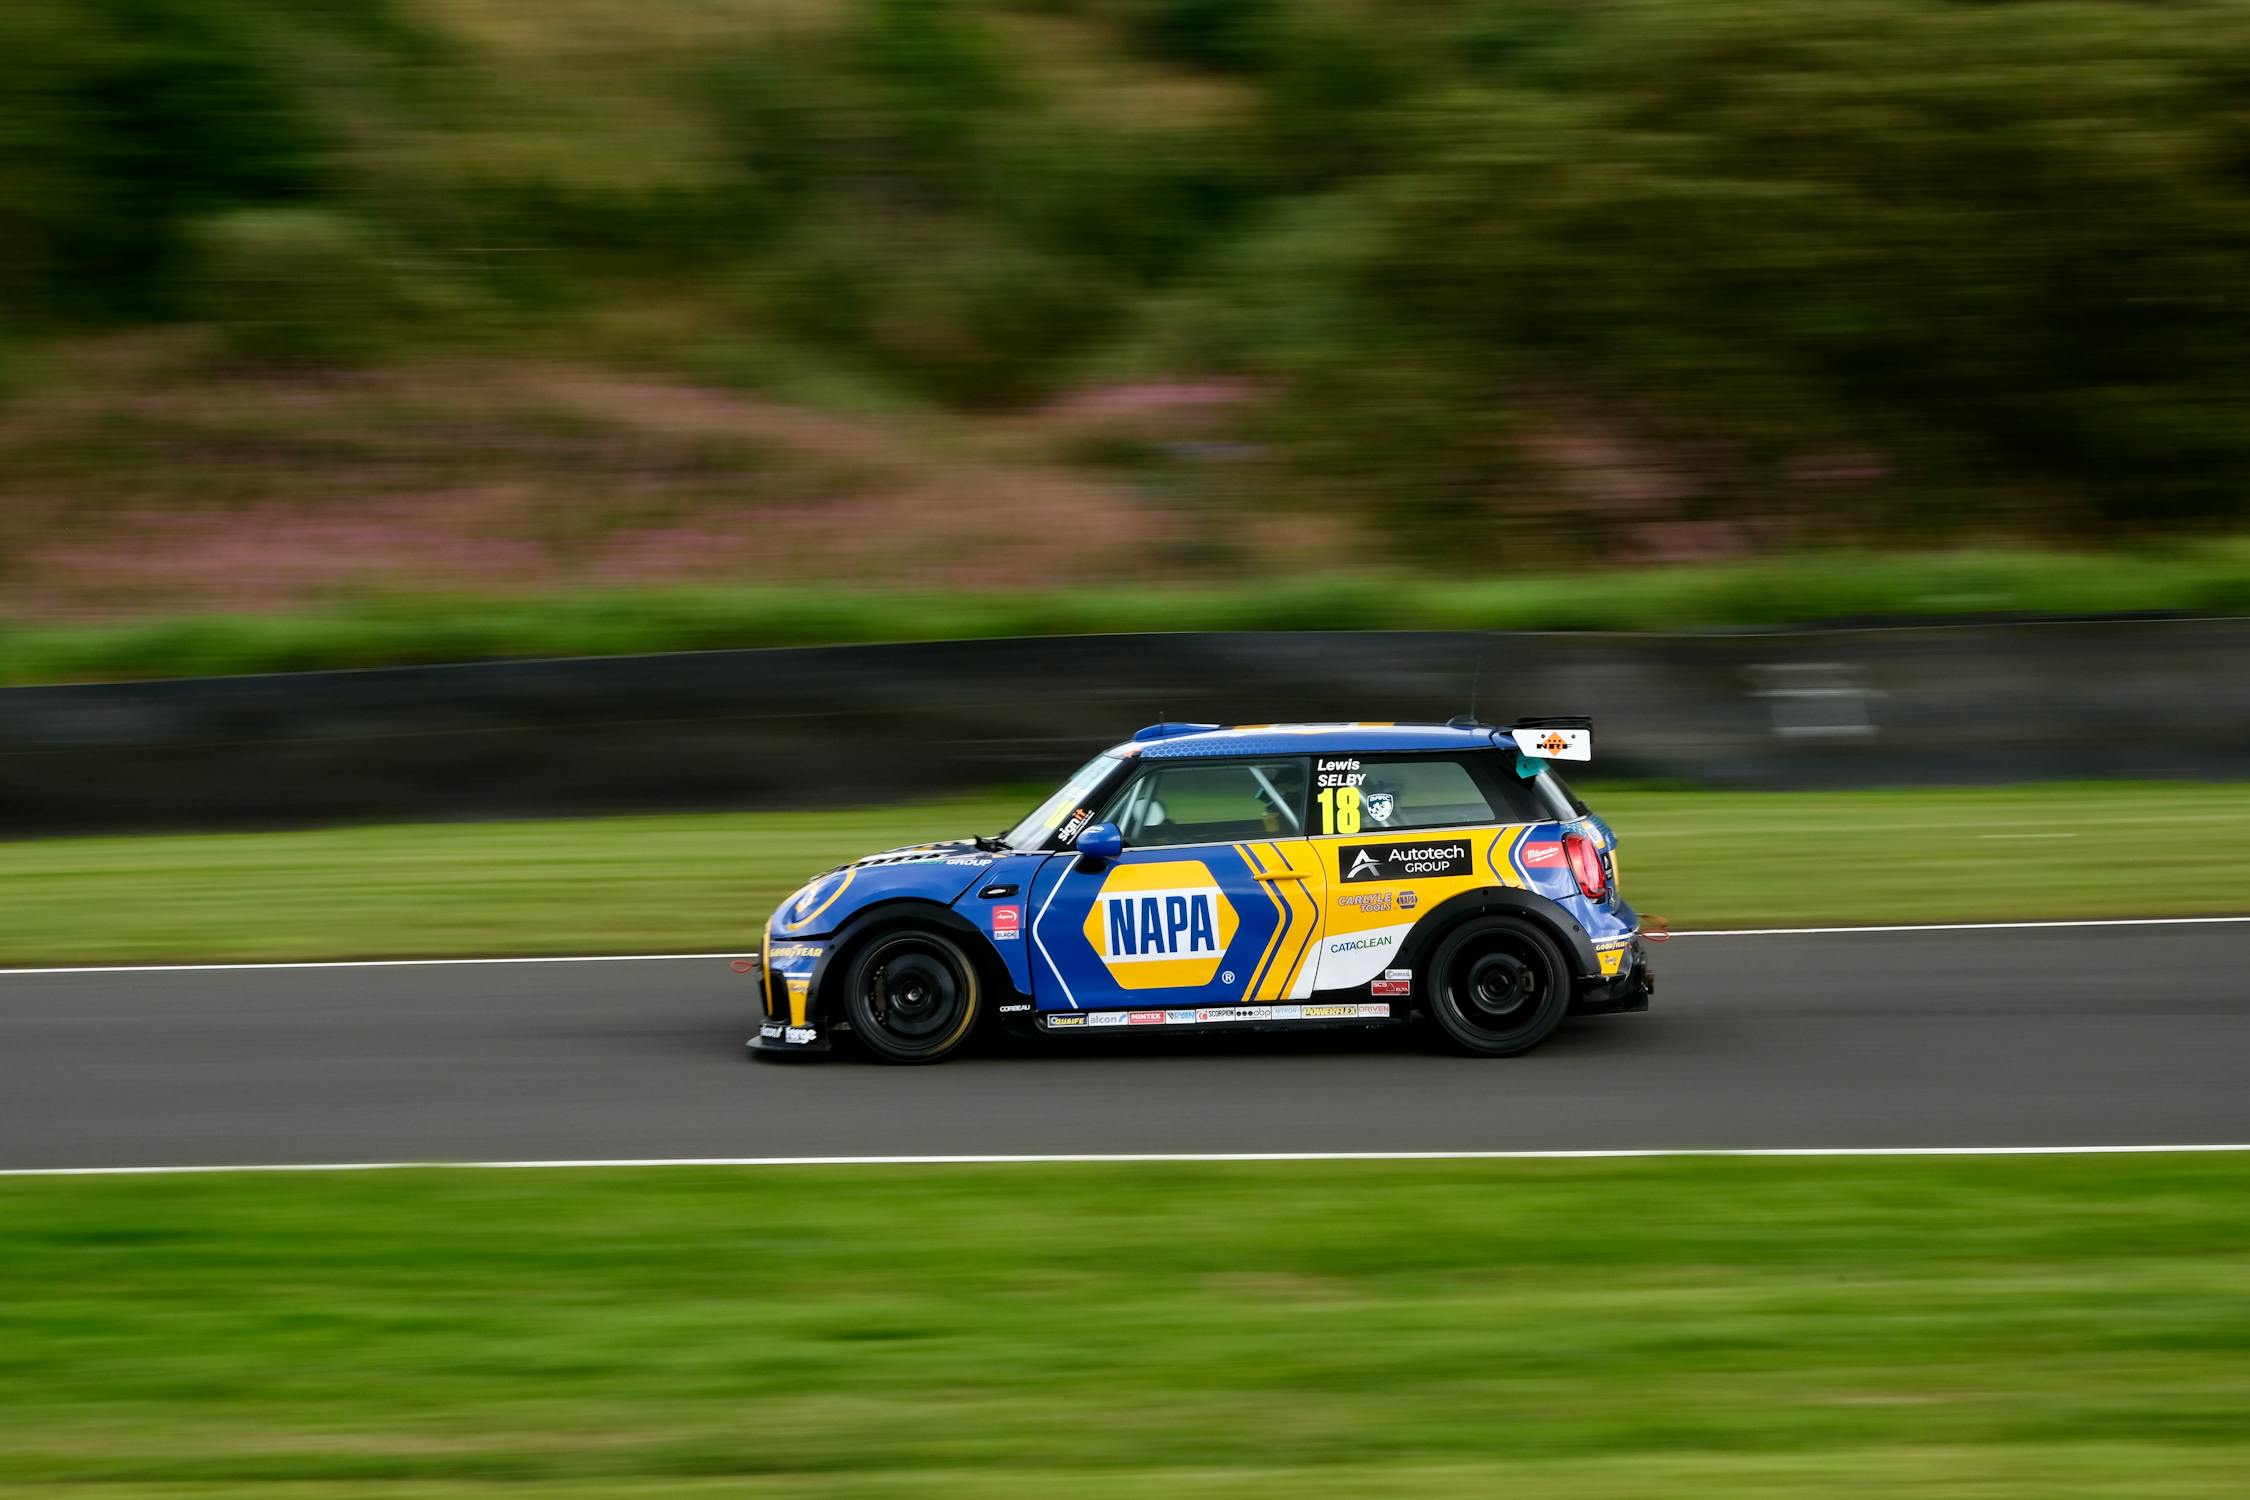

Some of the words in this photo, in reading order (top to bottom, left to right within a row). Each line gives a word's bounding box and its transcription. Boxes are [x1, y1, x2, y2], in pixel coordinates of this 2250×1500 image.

[1317, 758, 1360, 771] Lewis
[1317, 774, 1366, 787] SELBY
[1317, 786, 1360, 834] 18
[1388, 844, 1464, 862] Autotech
[1405, 860, 1450, 873] GROUP
[1338, 893, 1392, 906] CARLYLE
[1360, 903, 1392, 912] TOOLS
[1109, 894, 1216, 956] NAPA
[1330, 936, 1392, 953] CATACLEAN
[1304, 1006, 1356, 1016] POWERFLEX
[1090, 1016, 1117, 1024] alcon
